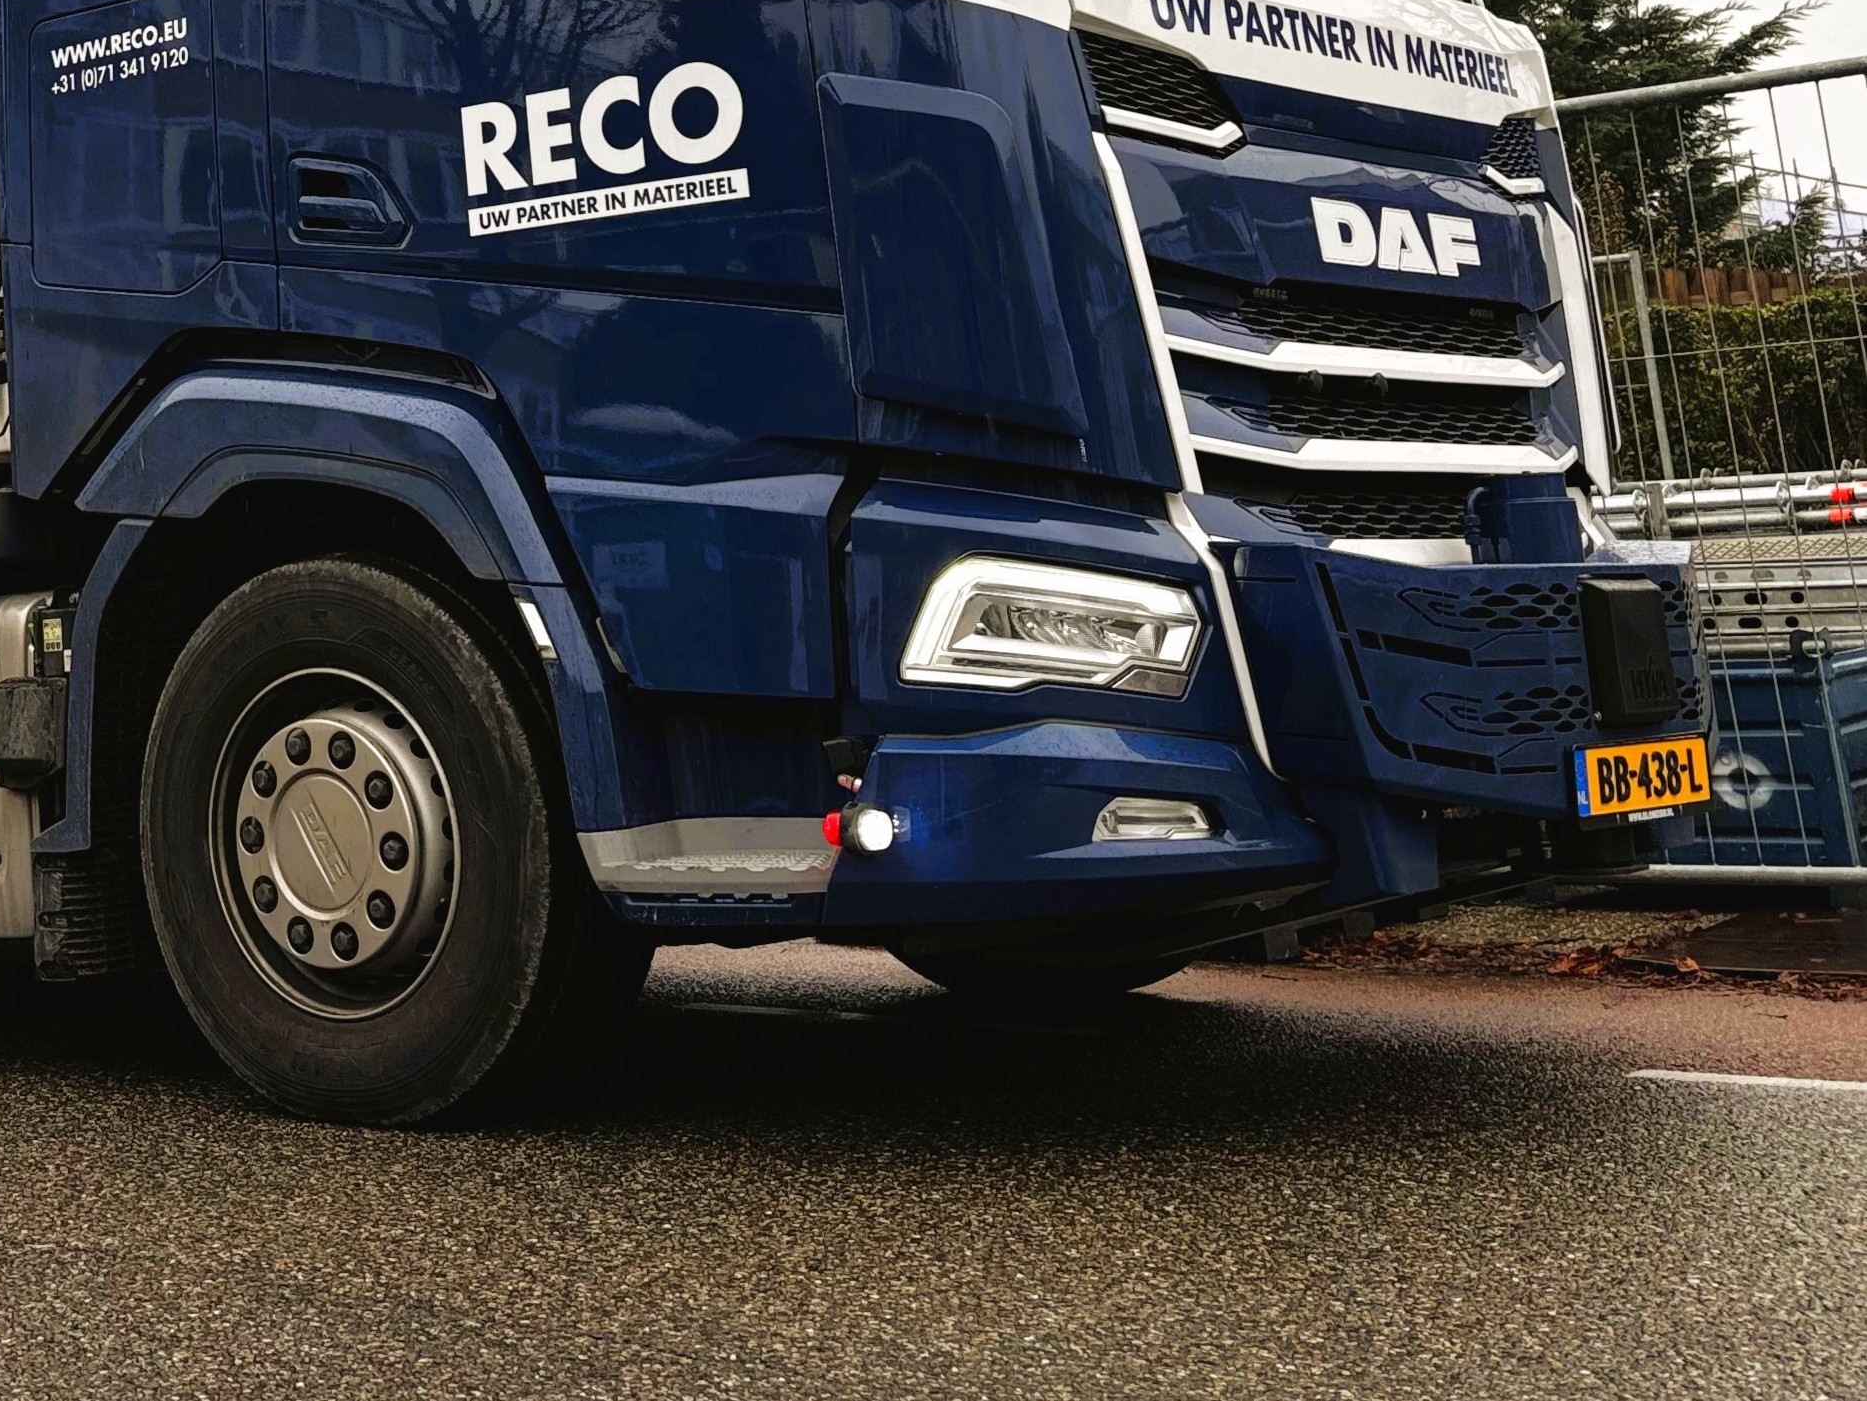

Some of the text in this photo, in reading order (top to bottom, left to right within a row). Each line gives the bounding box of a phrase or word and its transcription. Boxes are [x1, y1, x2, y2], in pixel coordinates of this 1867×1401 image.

[50, 17, 188, 68] WWW.RECO.EU
[51, 46, 189, 95] +31 (0)71 341 9120
[1365, 25, 1399, 71] IN
[1404, 34, 1519, 98] MATERIEEL
[460, 61, 744, 197] RECO
[479, 176, 738, 230] UW PARTNER IN MATERIEEL
[1310, 196, 1482, 278] DAF
[1596, 748, 1704, 805] BB-438-L
